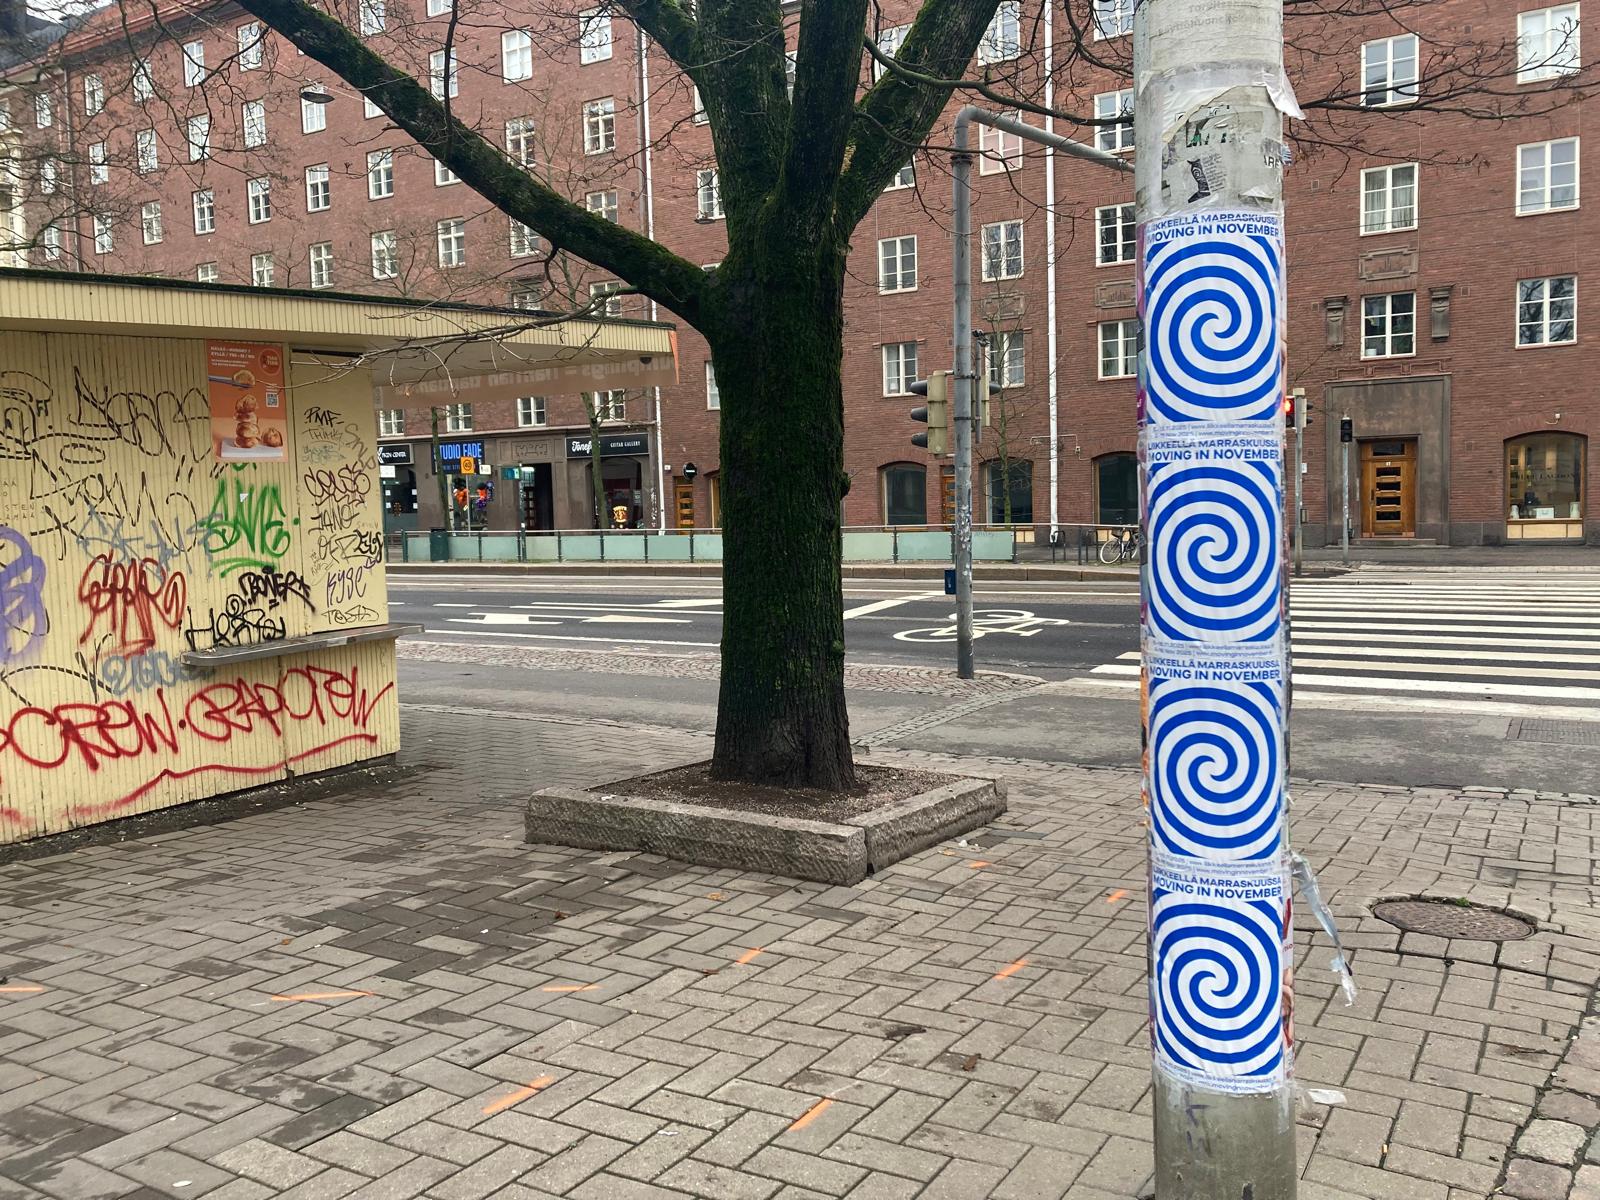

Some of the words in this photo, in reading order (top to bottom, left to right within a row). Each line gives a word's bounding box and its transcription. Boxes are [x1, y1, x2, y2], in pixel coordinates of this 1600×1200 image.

[1198, 225, 1212, 235] IN
[1216, 223, 1279, 237] NOVEMBER
[434, 444, 460, 460] TUDIO
[463, 442, 482, 459] FADE
[1195, 450, 1210, 460] IN
[1213, 449, 1279, 460] NOVEMBER
[1195, 670, 1208, 680] IN
[1212, 669, 1280, 681] NOVEMBER
[1153, 874, 1194, 894] MOVING
[1197, 886, 1211, 897] IN
[1215, 886, 1281, 899] NOVEMBER
